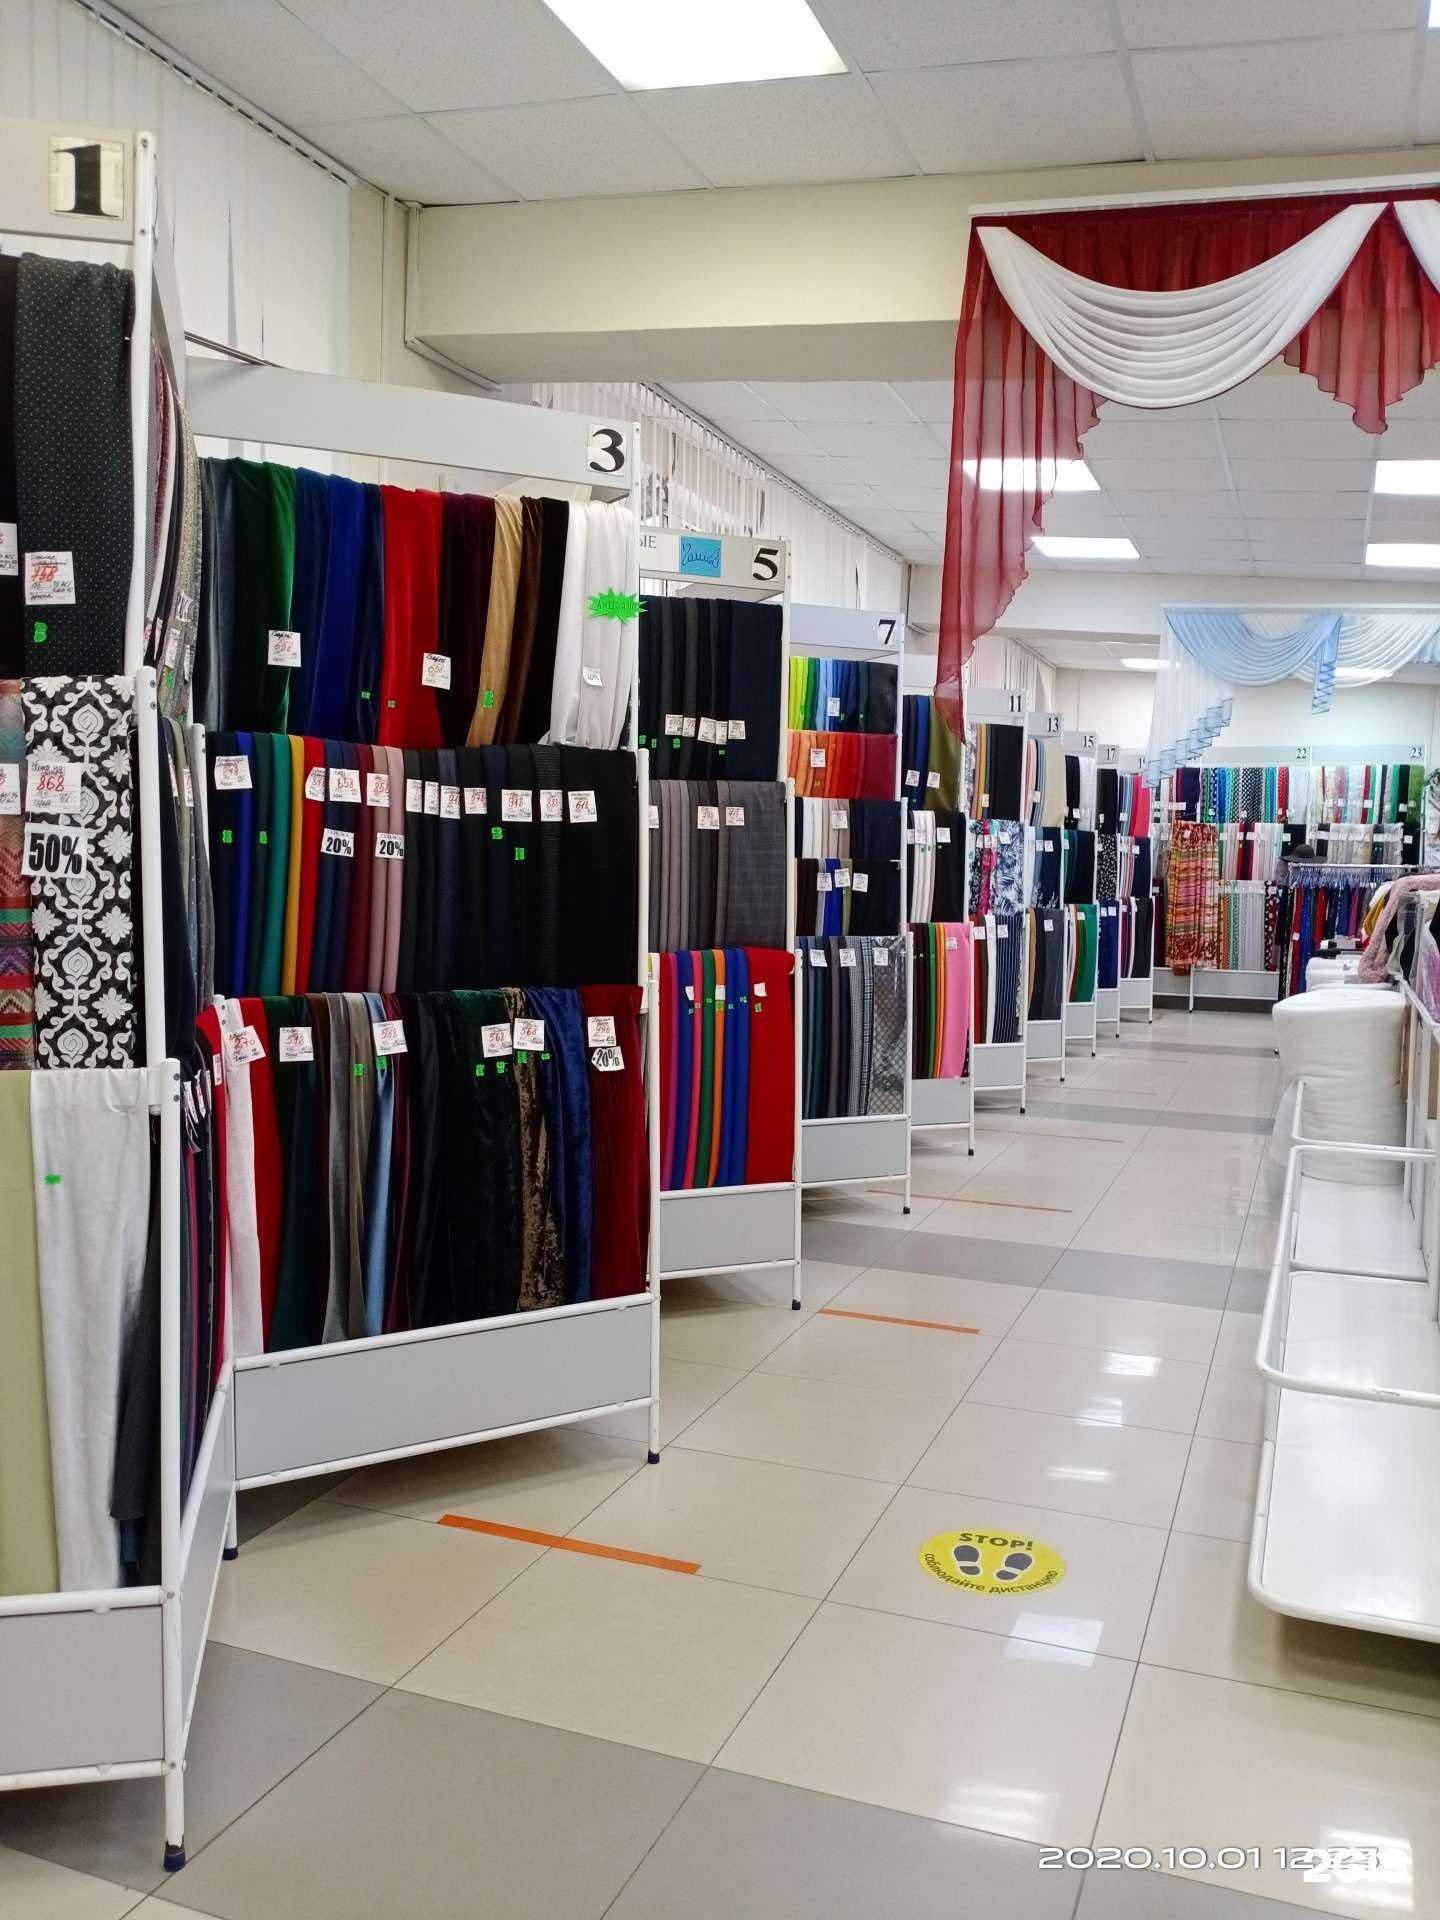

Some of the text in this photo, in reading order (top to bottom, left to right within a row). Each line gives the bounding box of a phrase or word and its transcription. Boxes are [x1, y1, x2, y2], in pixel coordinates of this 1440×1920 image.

[54, 144, 119, 218] 1
[590, 428, 625, 473] 3
[752, 548, 779, 581] 5
[878, 619, 897, 645] 7
[1009, 695, 1022, 712] 11
[1047, 717, 1060, 733] 13
[1083, 736, 1094, 748] 15
[1106, 748, 1116, 761] 17
[1296, 748, 1307, 759] 22
[1410, 748, 1423, 759] 23
[37, 775, 65, 792] 868
[28, 832, 83, 875] 50%
[326, 837, 352, 855] 20%
[379, 839, 404, 856] 20%
[958, 1532, 1034, 1551] STOP!
[924, 1553, 1059, 1594] соблюдайте дистанцию
